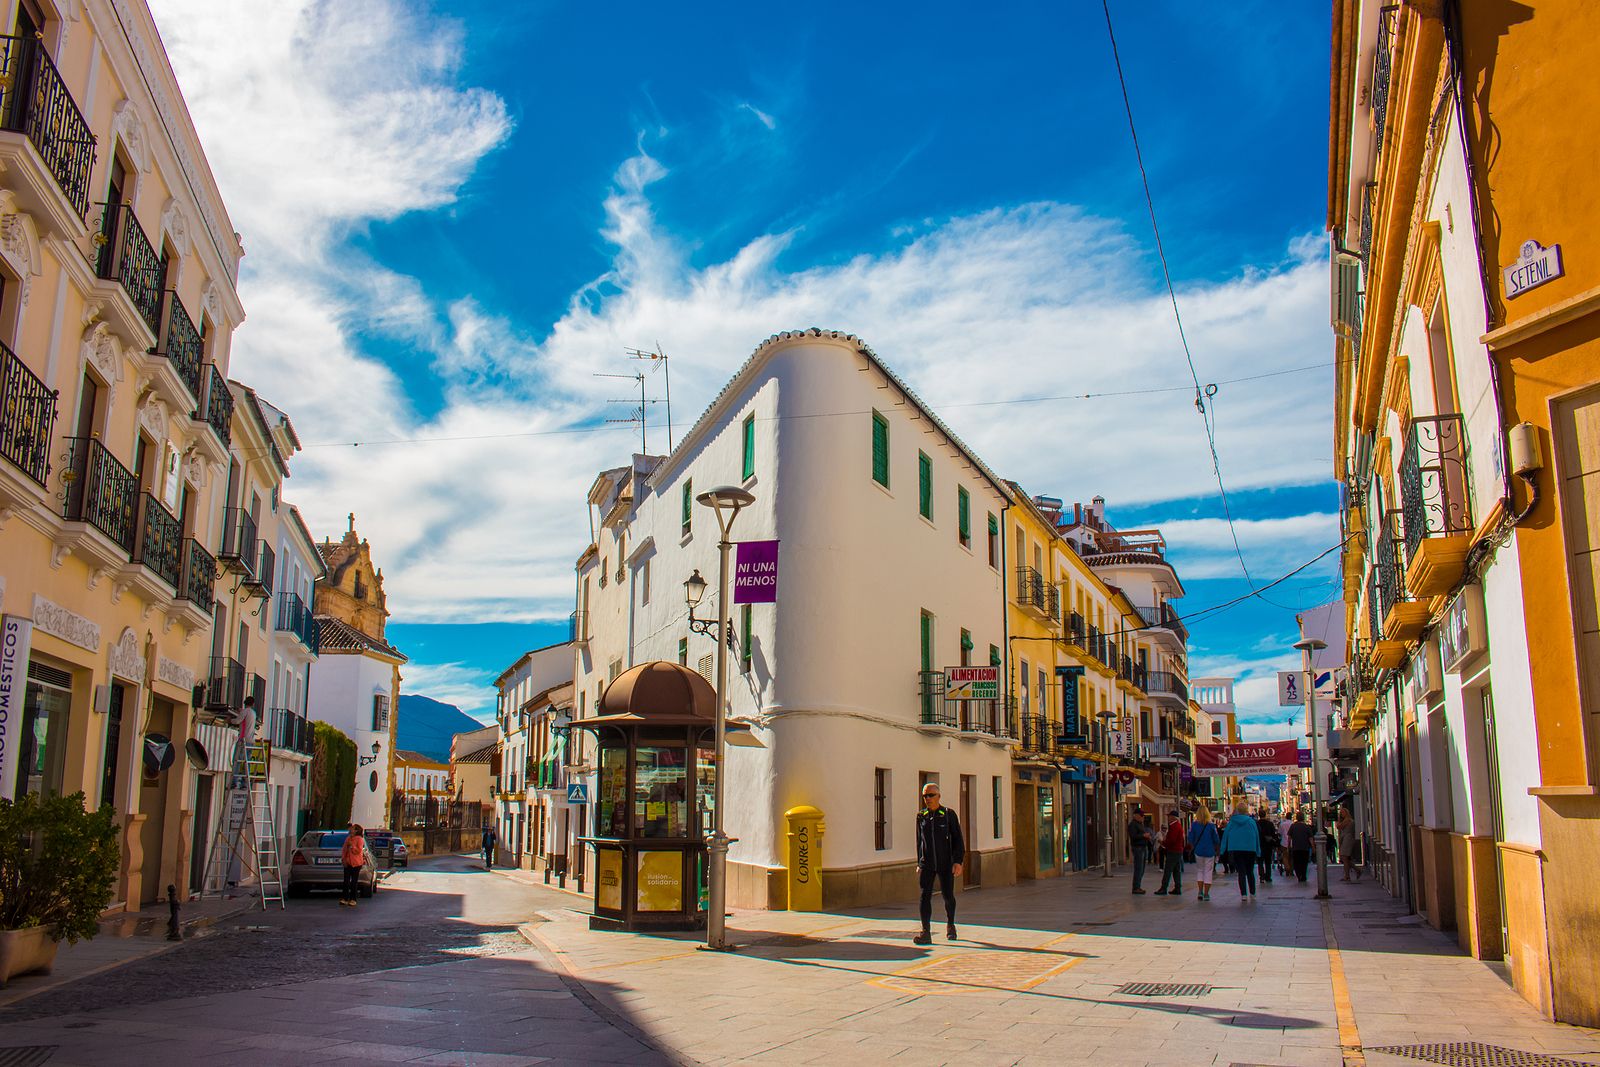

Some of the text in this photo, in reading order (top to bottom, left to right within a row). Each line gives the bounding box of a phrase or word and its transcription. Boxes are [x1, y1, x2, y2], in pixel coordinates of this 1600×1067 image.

[1510, 257, 1552, 293] SETENIL
[738, 562, 775, 573] NI UNA
[736, 575, 776, 587] MENOS
[951, 669, 997, 681] ALIMENTACION
[1286, 690, 1298, 700] 25
[1065, 680, 1075, 733] MARYPAZ
[1125, 718, 1133, 758] GALINDO
[1228, 747, 1276, 759] ALFARO
[797, 826, 809, 884] CORREOS
